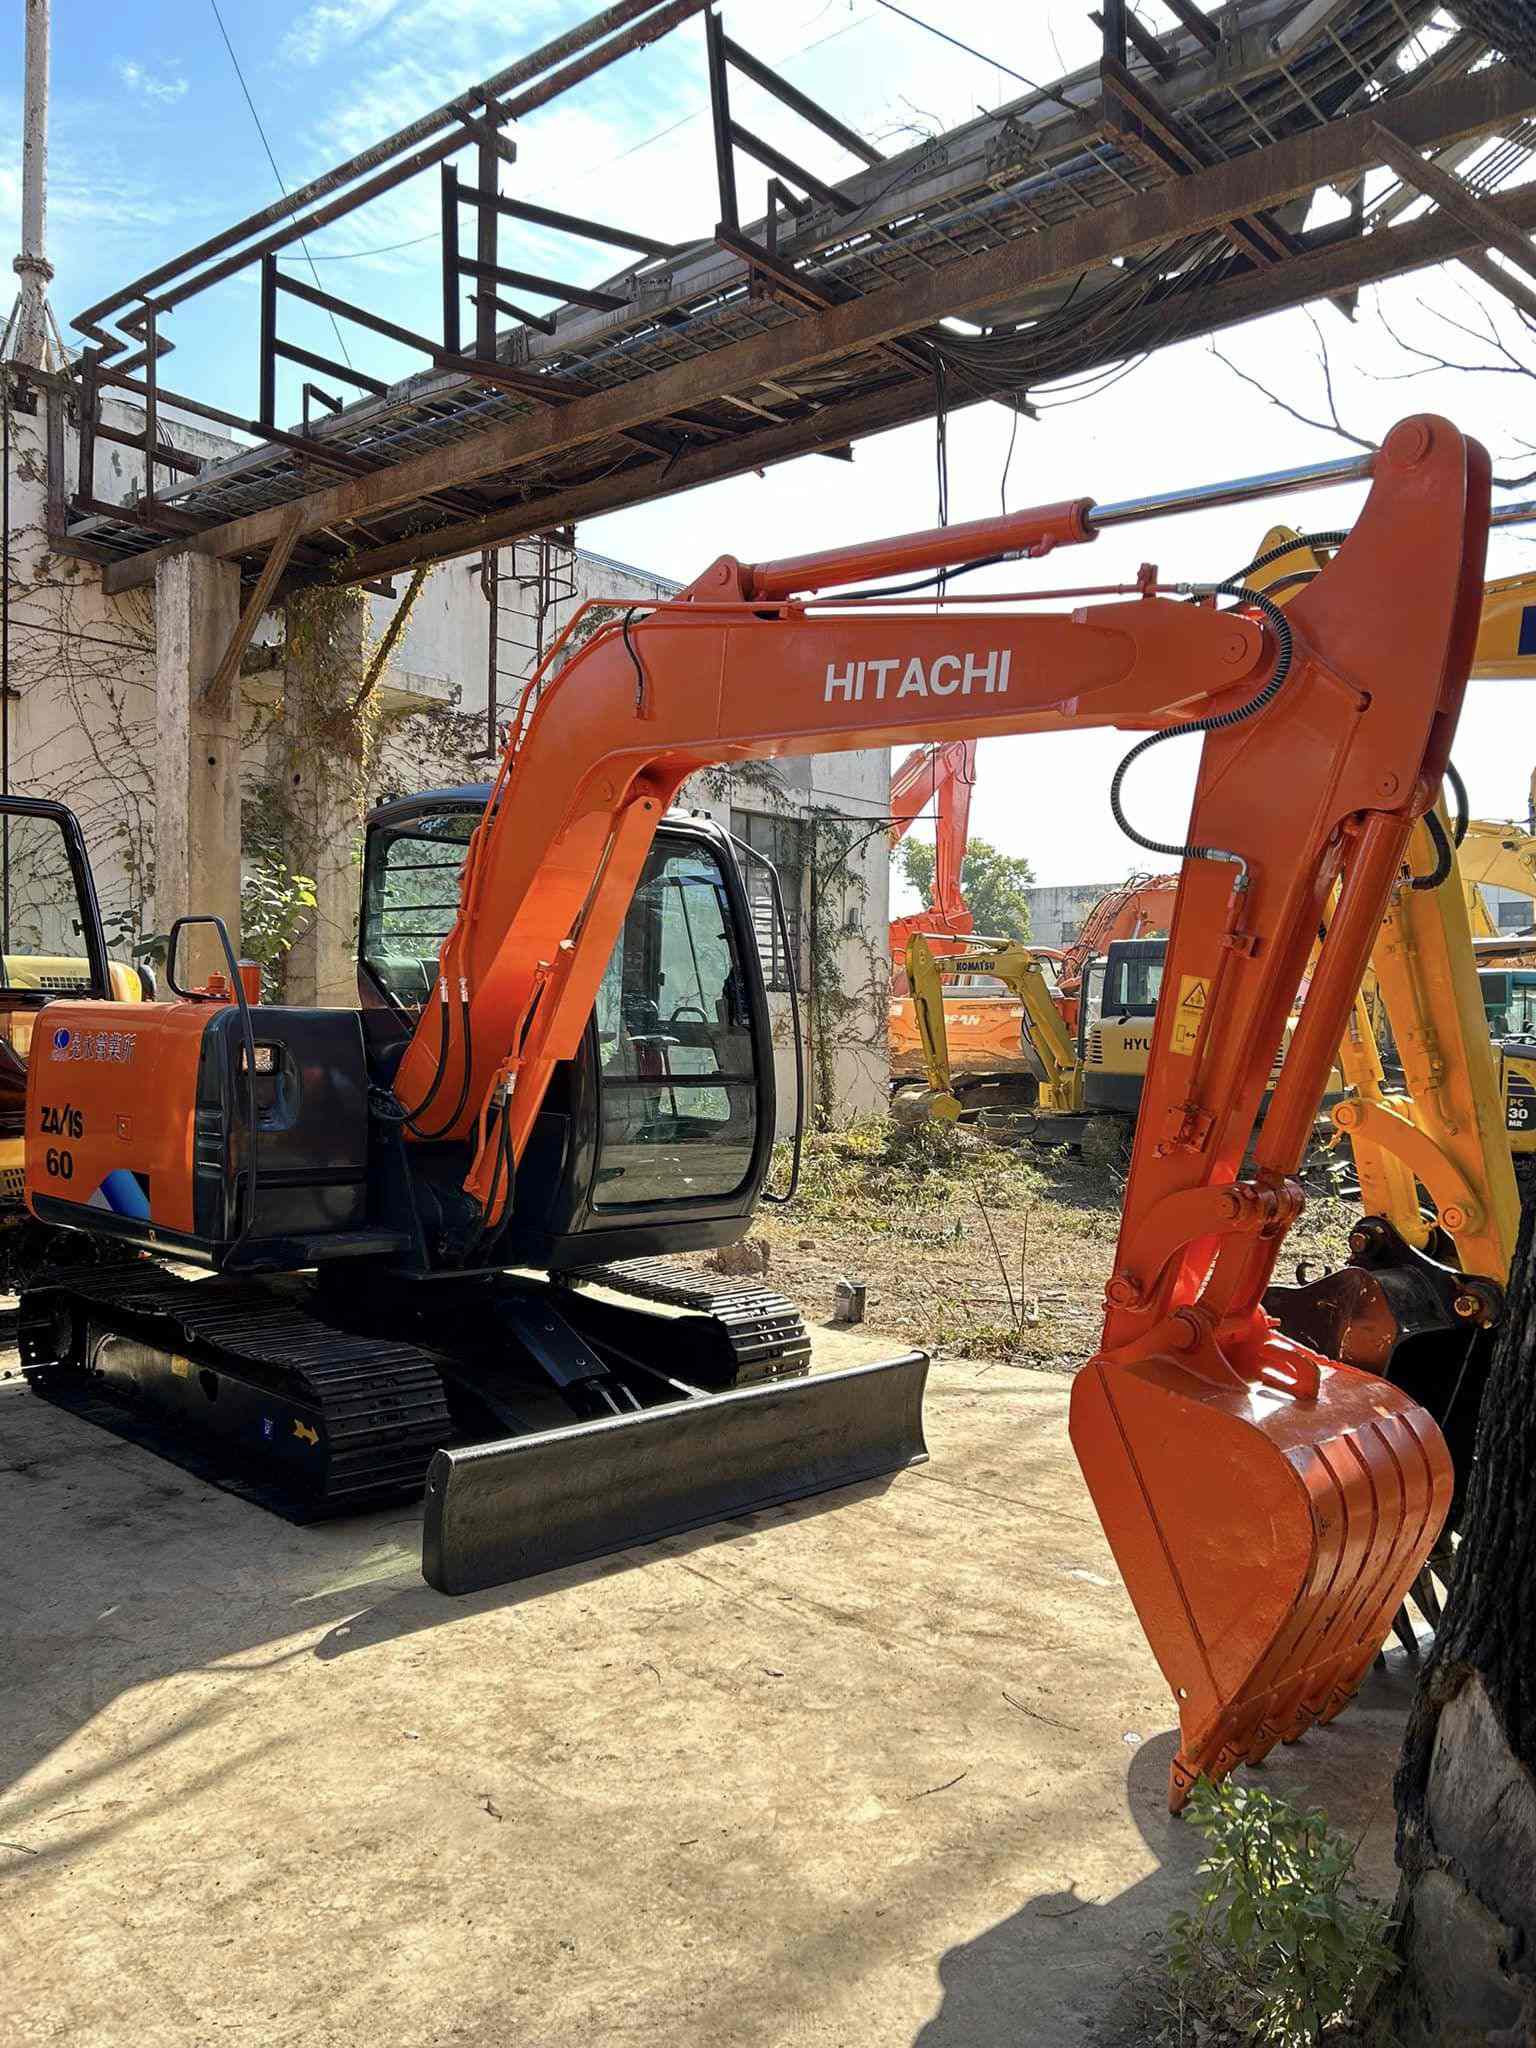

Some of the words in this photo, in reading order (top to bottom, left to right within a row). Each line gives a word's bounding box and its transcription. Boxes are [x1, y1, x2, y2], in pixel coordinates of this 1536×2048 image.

[824, 650, 1012, 702] HITACHI
[956, 960, 996, 971] KOMATSU
[1510, 1098, 1525, 1107] PC
[1508, 1108, 1529, 1119] 30
[46, 1147, 74, 1180] 60
